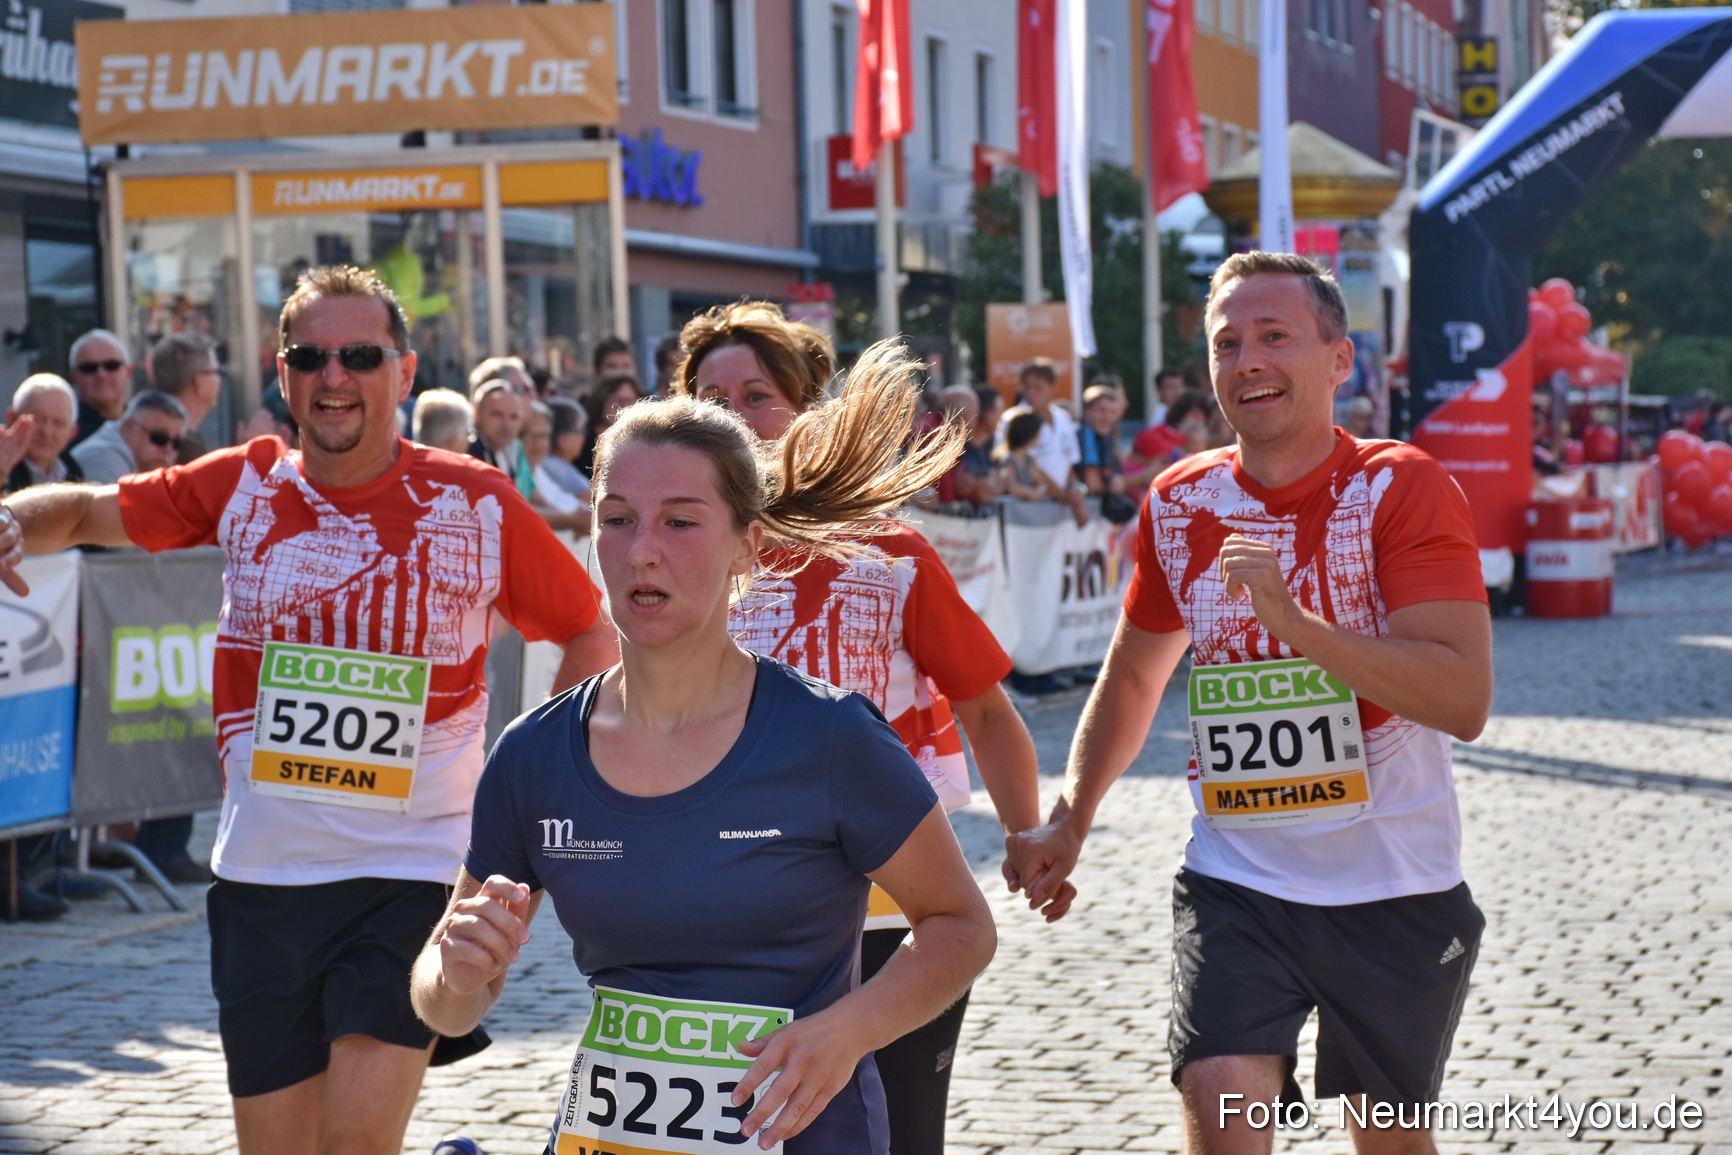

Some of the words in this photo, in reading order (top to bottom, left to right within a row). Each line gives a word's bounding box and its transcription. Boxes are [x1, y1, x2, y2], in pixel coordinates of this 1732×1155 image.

[97, 38, 590, 113] RUNMARKT.DE
[1443, 169, 1516, 224] PARTL
[1508, 90, 1626, 181] NEUMARKT
[274, 175, 465, 206] RUNMARKT.DE
[295, 560, 339, 579] 26.22
[271, 650, 414, 699] BOCK
[1198, 665, 1340, 710] BOCK
[269, 698, 400, 757] 5202
[408, 717, 415, 727] S
[1208, 716, 1335, 772] 5201
[1342, 716, 1350, 727] S
[279, 760, 376, 790] STEFAN
[1216, 780, 1346, 810] MATTHIAS
[566, 839, 590, 848] MÜNCH
[596, 840, 623, 849] MÜNCH
[594, 999, 768, 1061] BOCK
[586, 1064, 755, 1146] 5223
